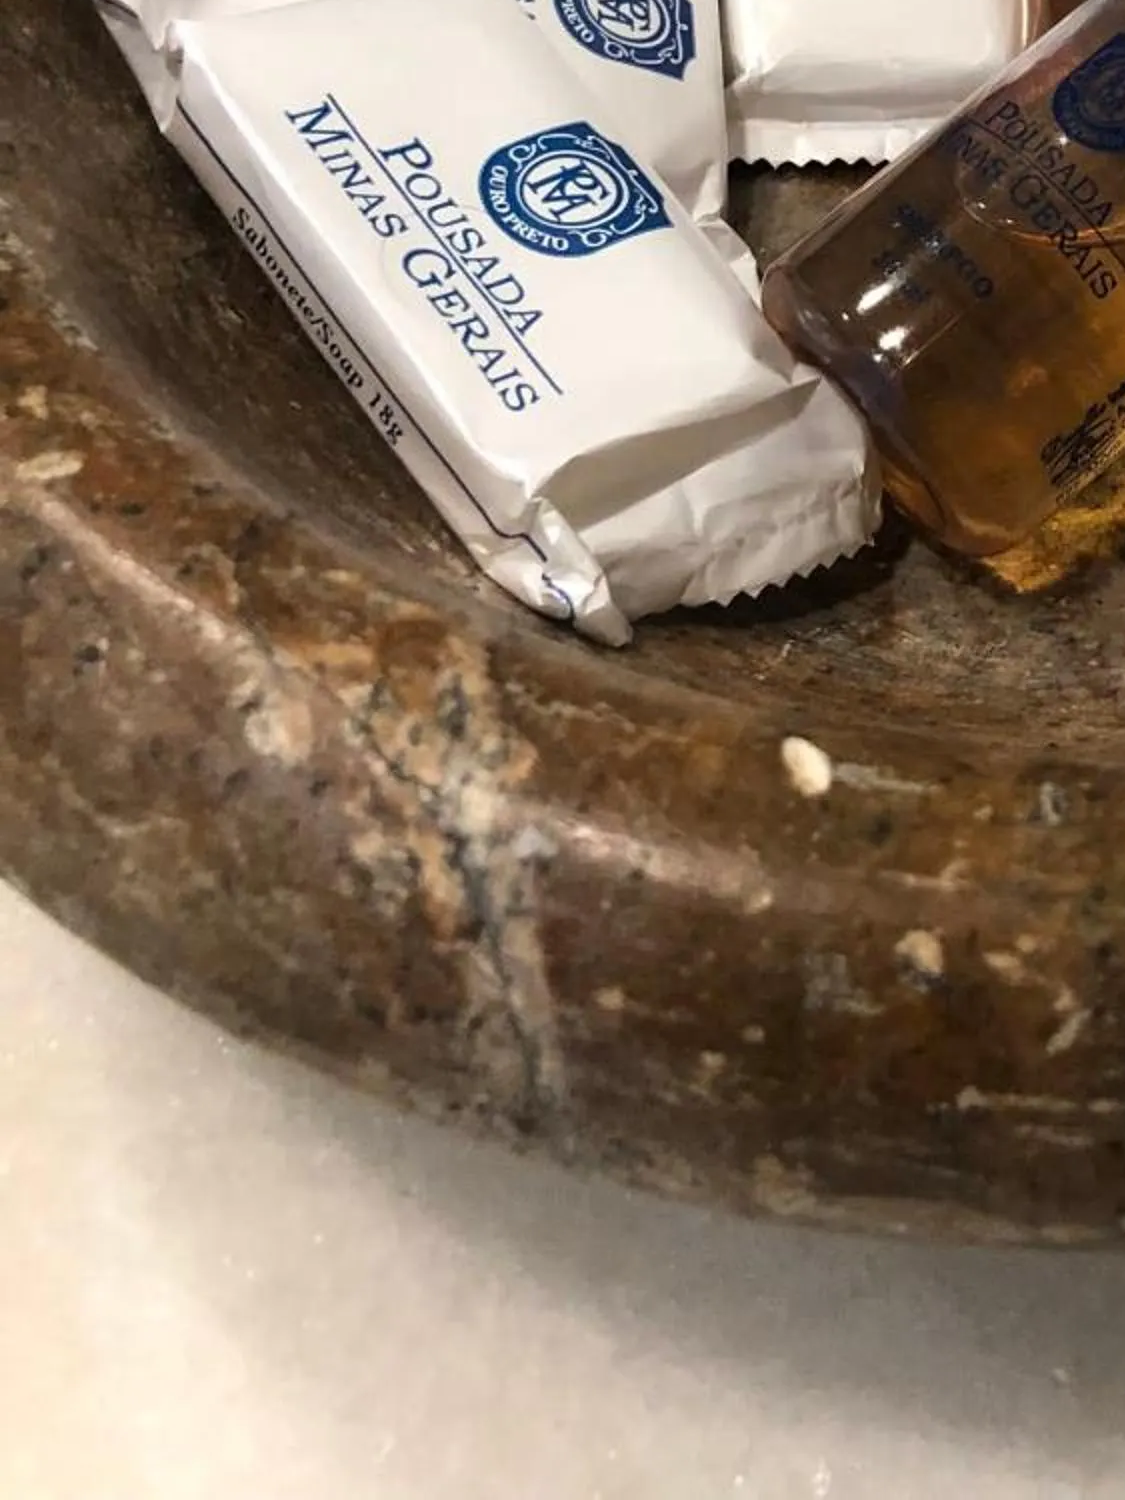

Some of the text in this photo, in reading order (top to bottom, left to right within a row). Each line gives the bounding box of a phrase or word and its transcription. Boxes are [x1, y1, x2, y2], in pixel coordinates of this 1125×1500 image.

[378, 137, 543, 336] POUSADA
[489, 165, 569, 251] OURO PRETO
[985, 101, 1113, 226] POUSADA
[1011, 174, 1118, 299] GERAIS
[232, 207, 403, 447] Sabonete/Soap 18g
[285, 101, 540, 412] MINAS GERAIS
